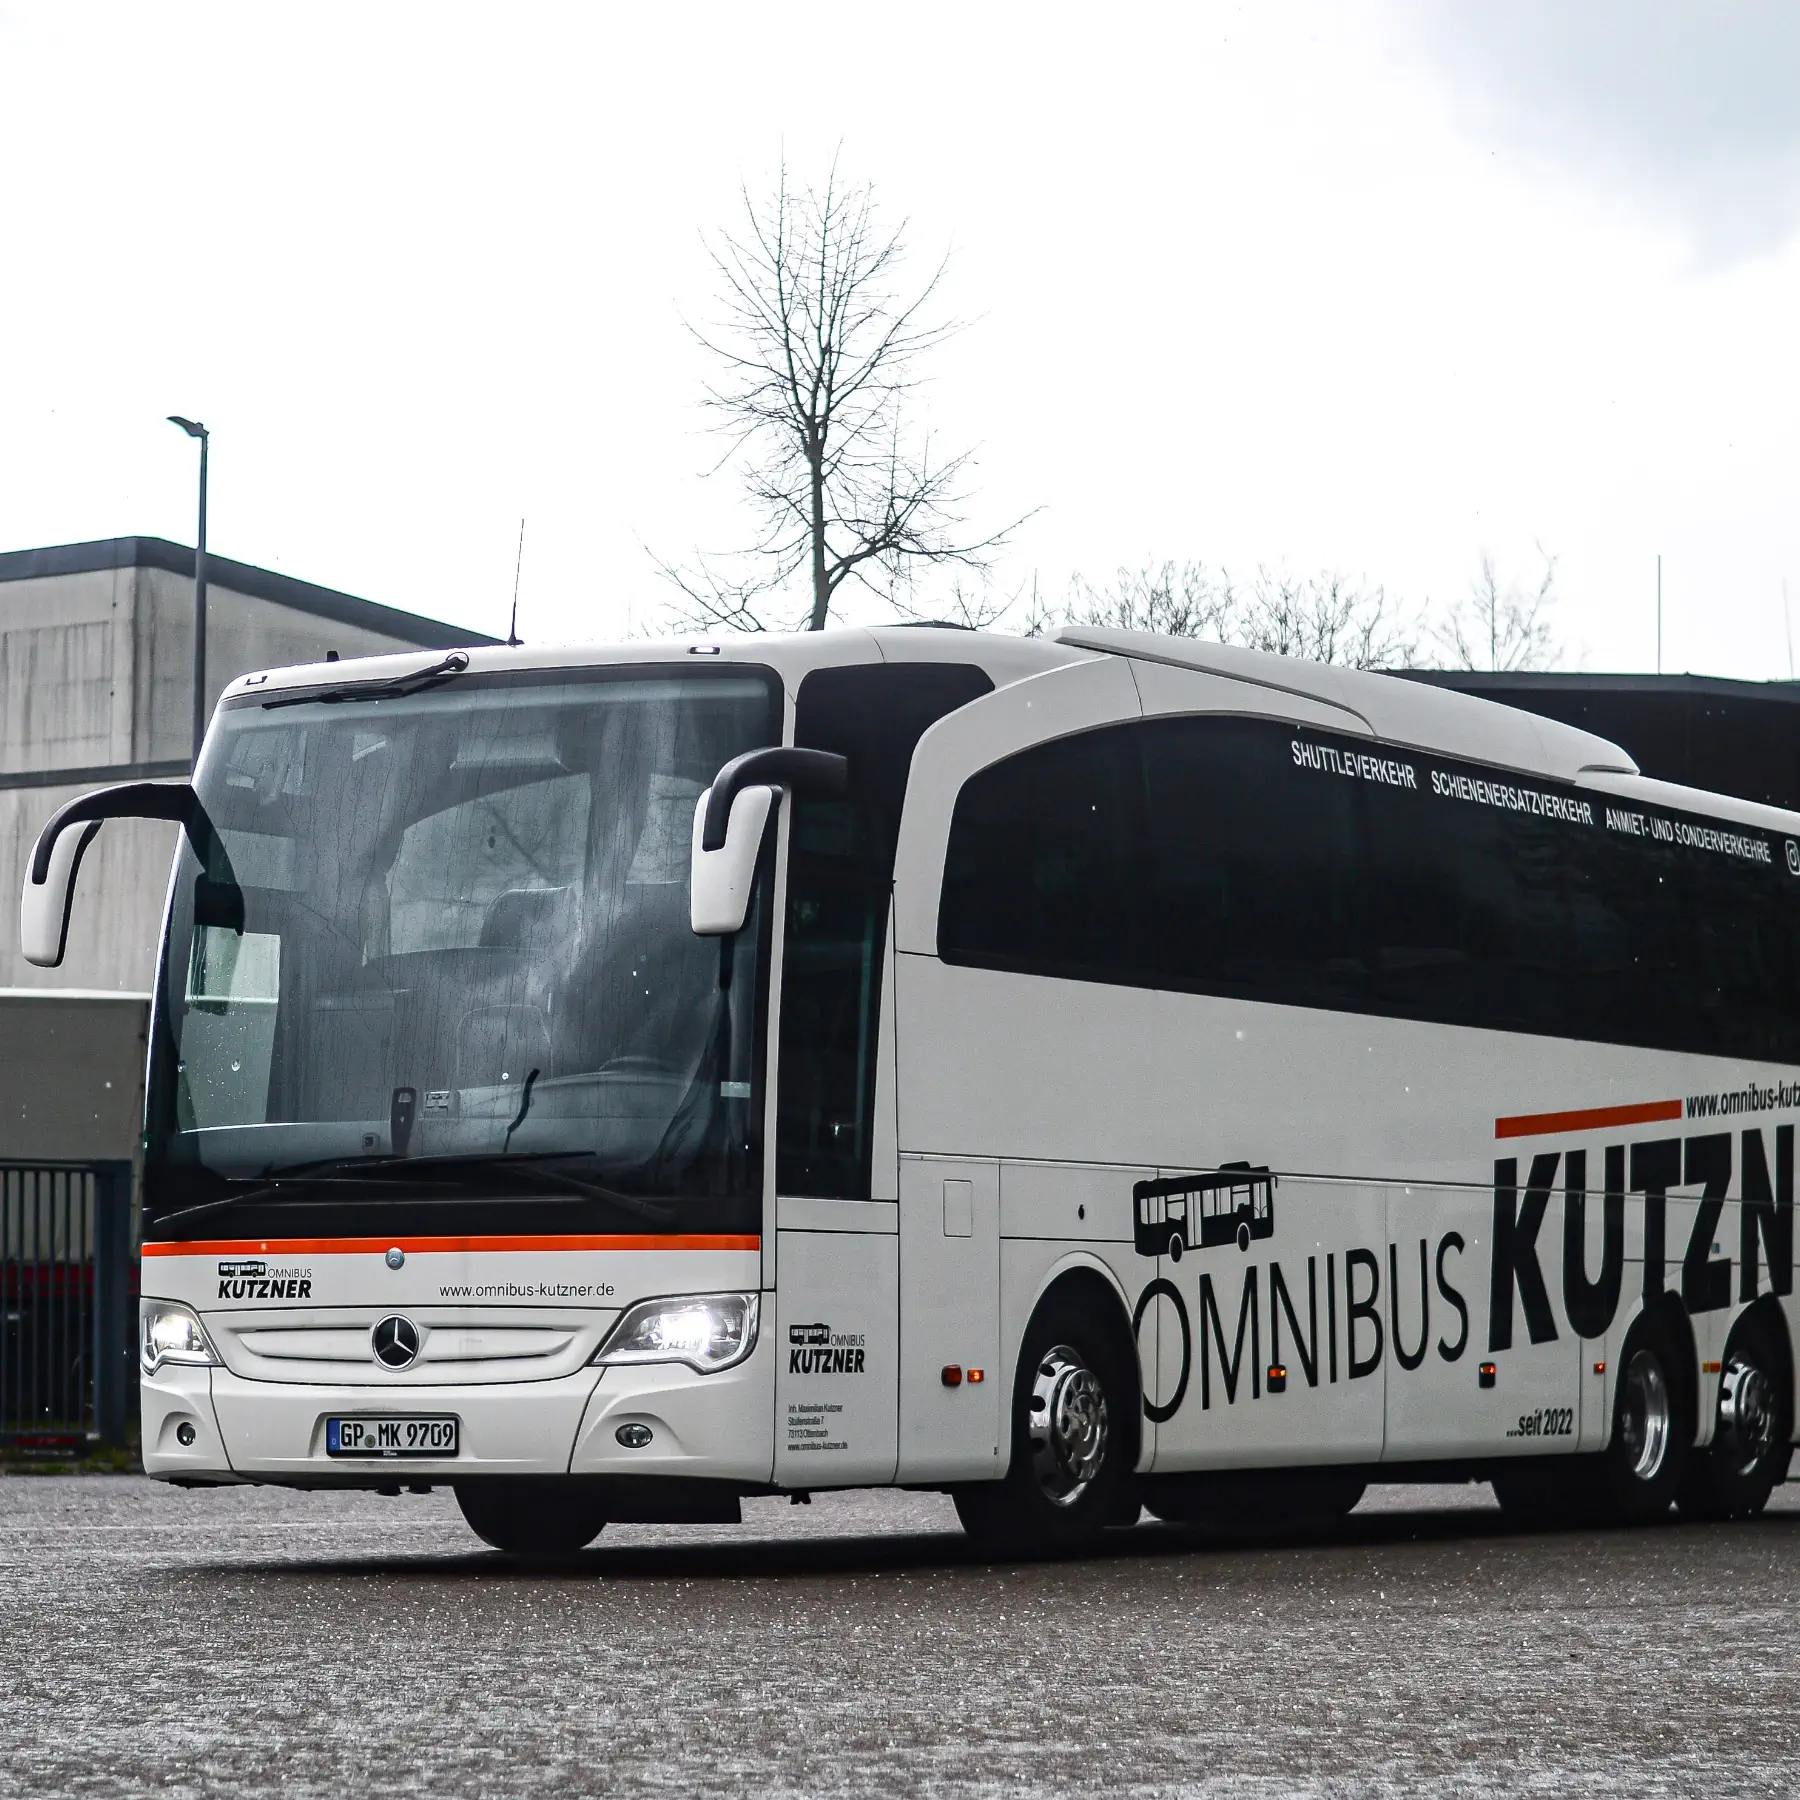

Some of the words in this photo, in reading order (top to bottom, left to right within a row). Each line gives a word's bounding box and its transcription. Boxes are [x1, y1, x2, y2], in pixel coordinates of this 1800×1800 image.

[1291, 740, 1417, 789] SHUTTLEVERKEHR
[1431, 770, 1594, 825] SCHIENENERSATZVERKEHR
[1605, 808, 1649, 836] ANMIET-
[1650, 817, 1674, 842] UND
[1675, 822, 1772, 863] SONDERVERKEHRE
[267, 1268, 312, 1279] OMNIBUS
[1131, 1231, 1468, 1424] OMNIBUS
[1488, 1124, 1794, 1353] KUTZN
[218, 1280, 312, 1299] KUTZNER
[439, 1283, 615, 1297] www.omnibus-kutzner.de
[831, 1334, 865, 1347] OMNIBUS
[789, 1349, 865, 1374] KUTZNER
[820, 1416, 825, 1424] 7
[1543, 1408, 1573, 1435] 2022
[341, 1423, 364, 1447] GP
[378, 1423, 401, 1447] MK
[406, 1423, 454, 1447] 9709
